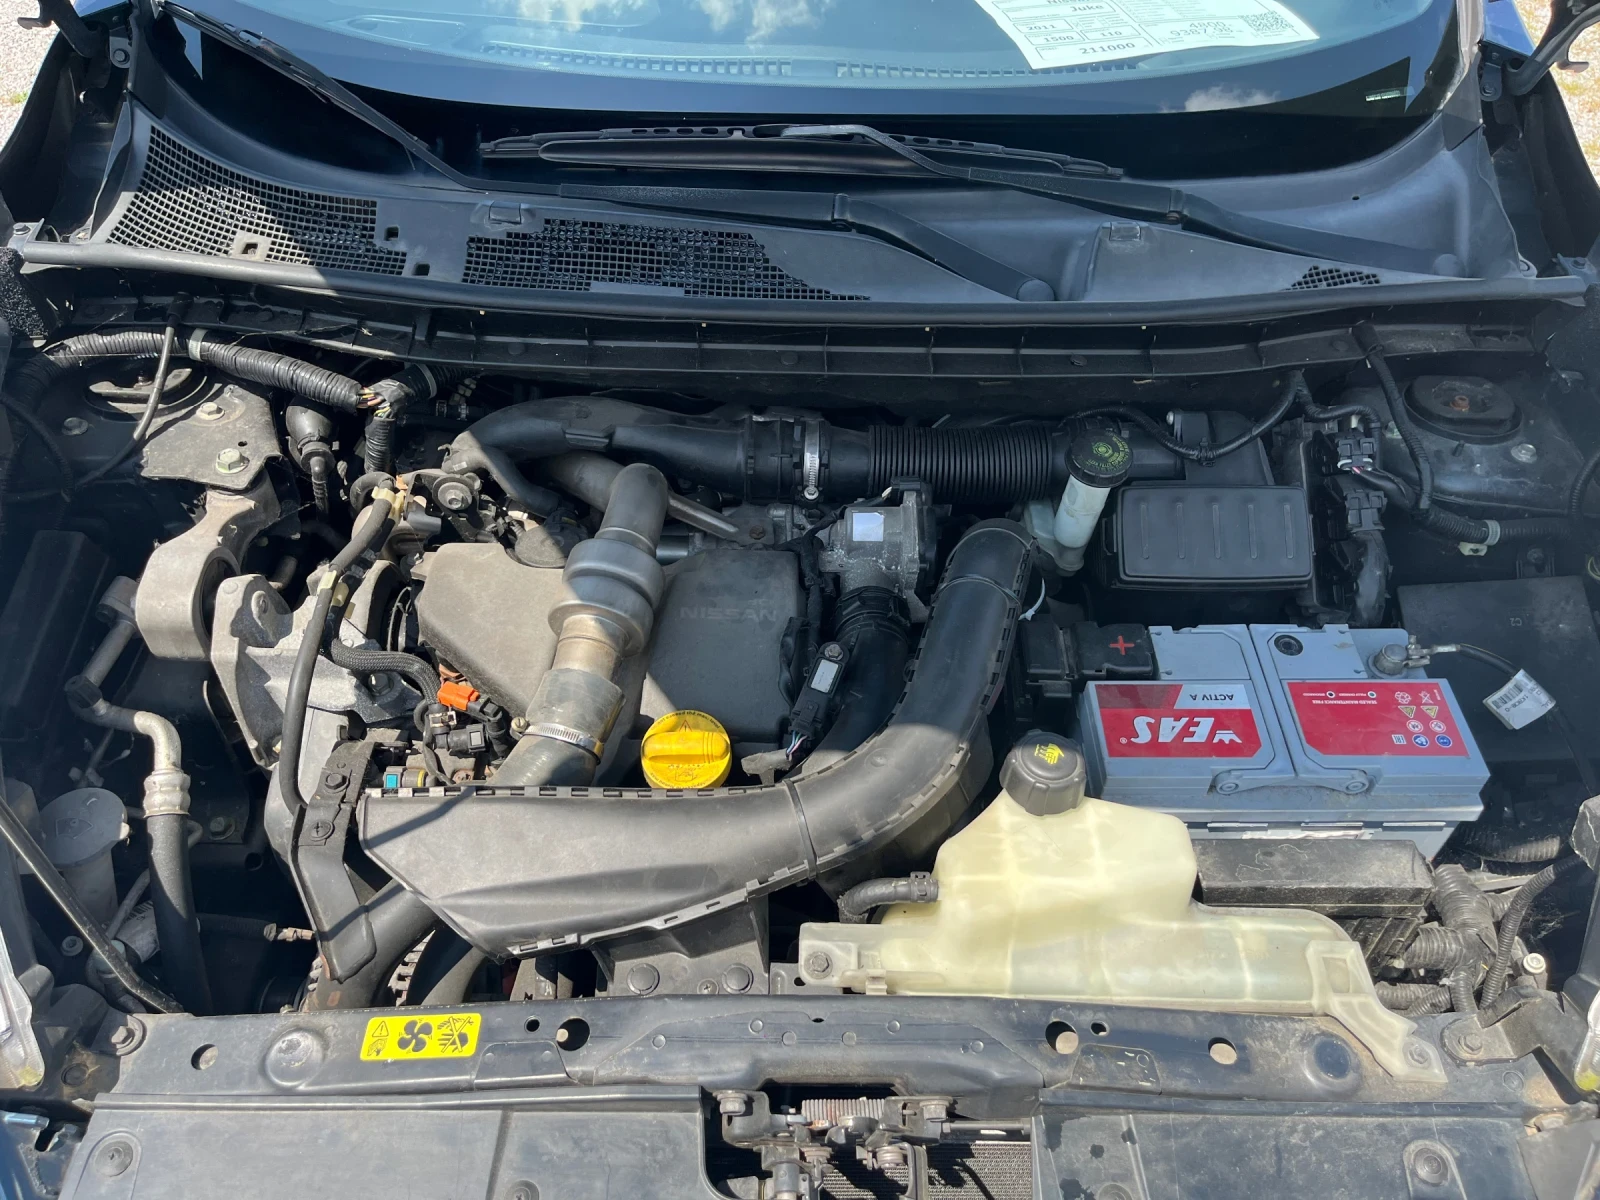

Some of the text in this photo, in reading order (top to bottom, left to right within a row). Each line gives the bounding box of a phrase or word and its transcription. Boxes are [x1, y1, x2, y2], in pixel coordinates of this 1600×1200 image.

[1079, 42, 1136, 54] 211000
[679, 606, 777, 622] NISSAN
[1130, 715, 1215, 743] EAS
